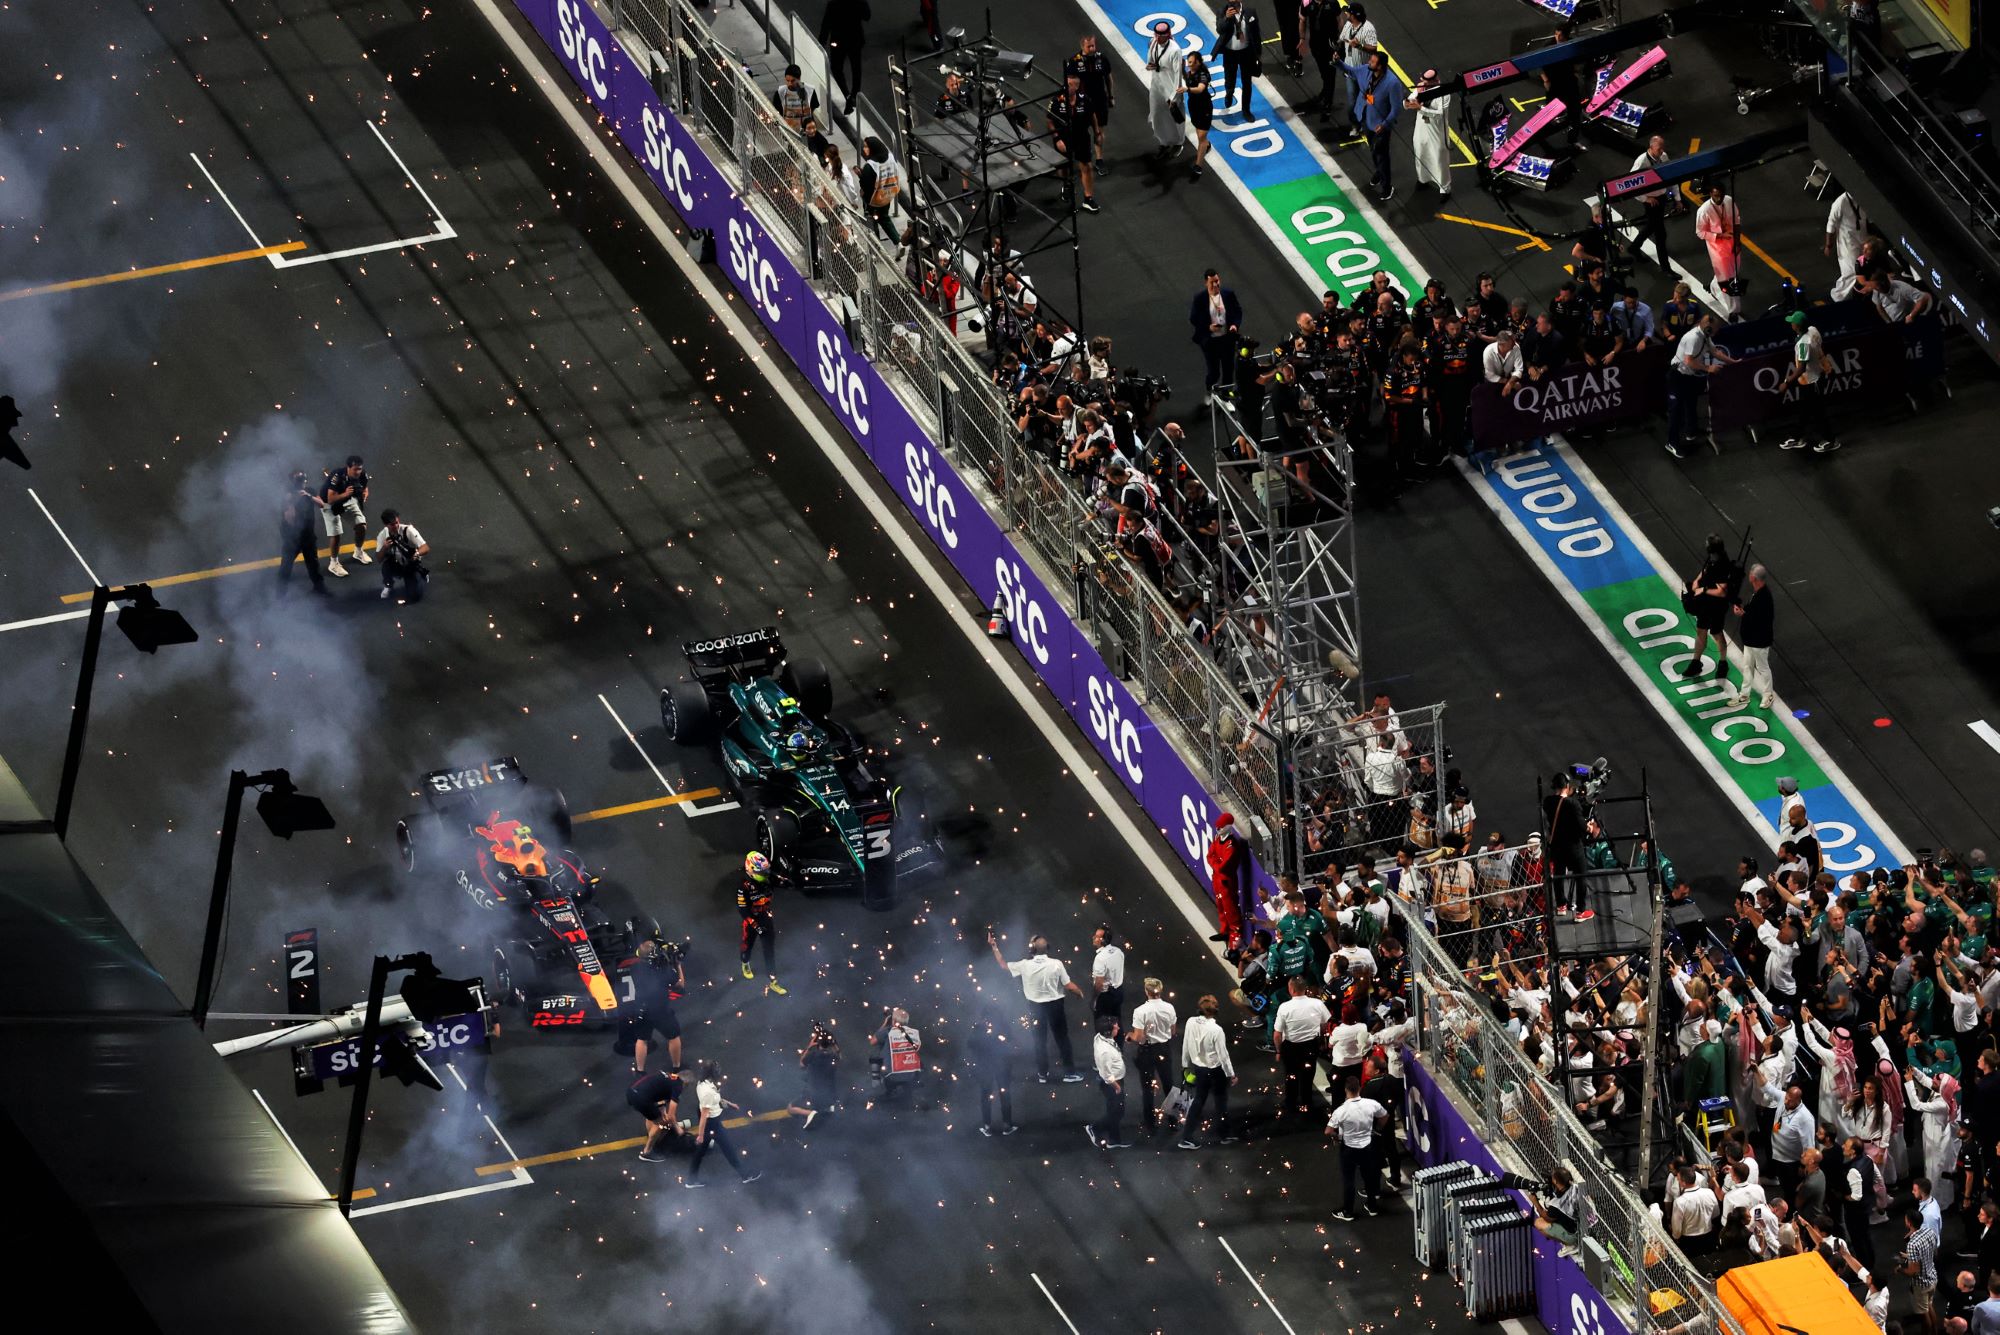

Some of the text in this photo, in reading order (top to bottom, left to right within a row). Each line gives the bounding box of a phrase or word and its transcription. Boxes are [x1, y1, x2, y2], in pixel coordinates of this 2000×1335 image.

[557, 0, 608, 100] stc
[641, 107, 694, 211] stc
[728, 217, 781, 322] stc
[816, 330, 870, 435] stc
[1512, 365, 1623, 414] QATAR
[1542, 390, 1623, 424] AIRWAYS
[904, 442, 958, 549] stc
[1491, 449, 1614, 558] aram
[995, 557, 1049, 665] stc
[696, 629, 769, 653] cognizant
[1622, 607, 1787, 765] aramco
[1087, 675, 1144, 785] stc
[430, 762, 508, 792] BYBIT
[829, 798, 850, 812] 14
[866, 829, 891, 860] 3
[1181, 794, 1214, 881] st
[800, 866, 840, 876] aramco
[562, 928, 588, 943] 11
[290, 949, 315, 979] 2
[532, 1010, 586, 1028] Red
[542, 995, 577, 1010] BYBIT
